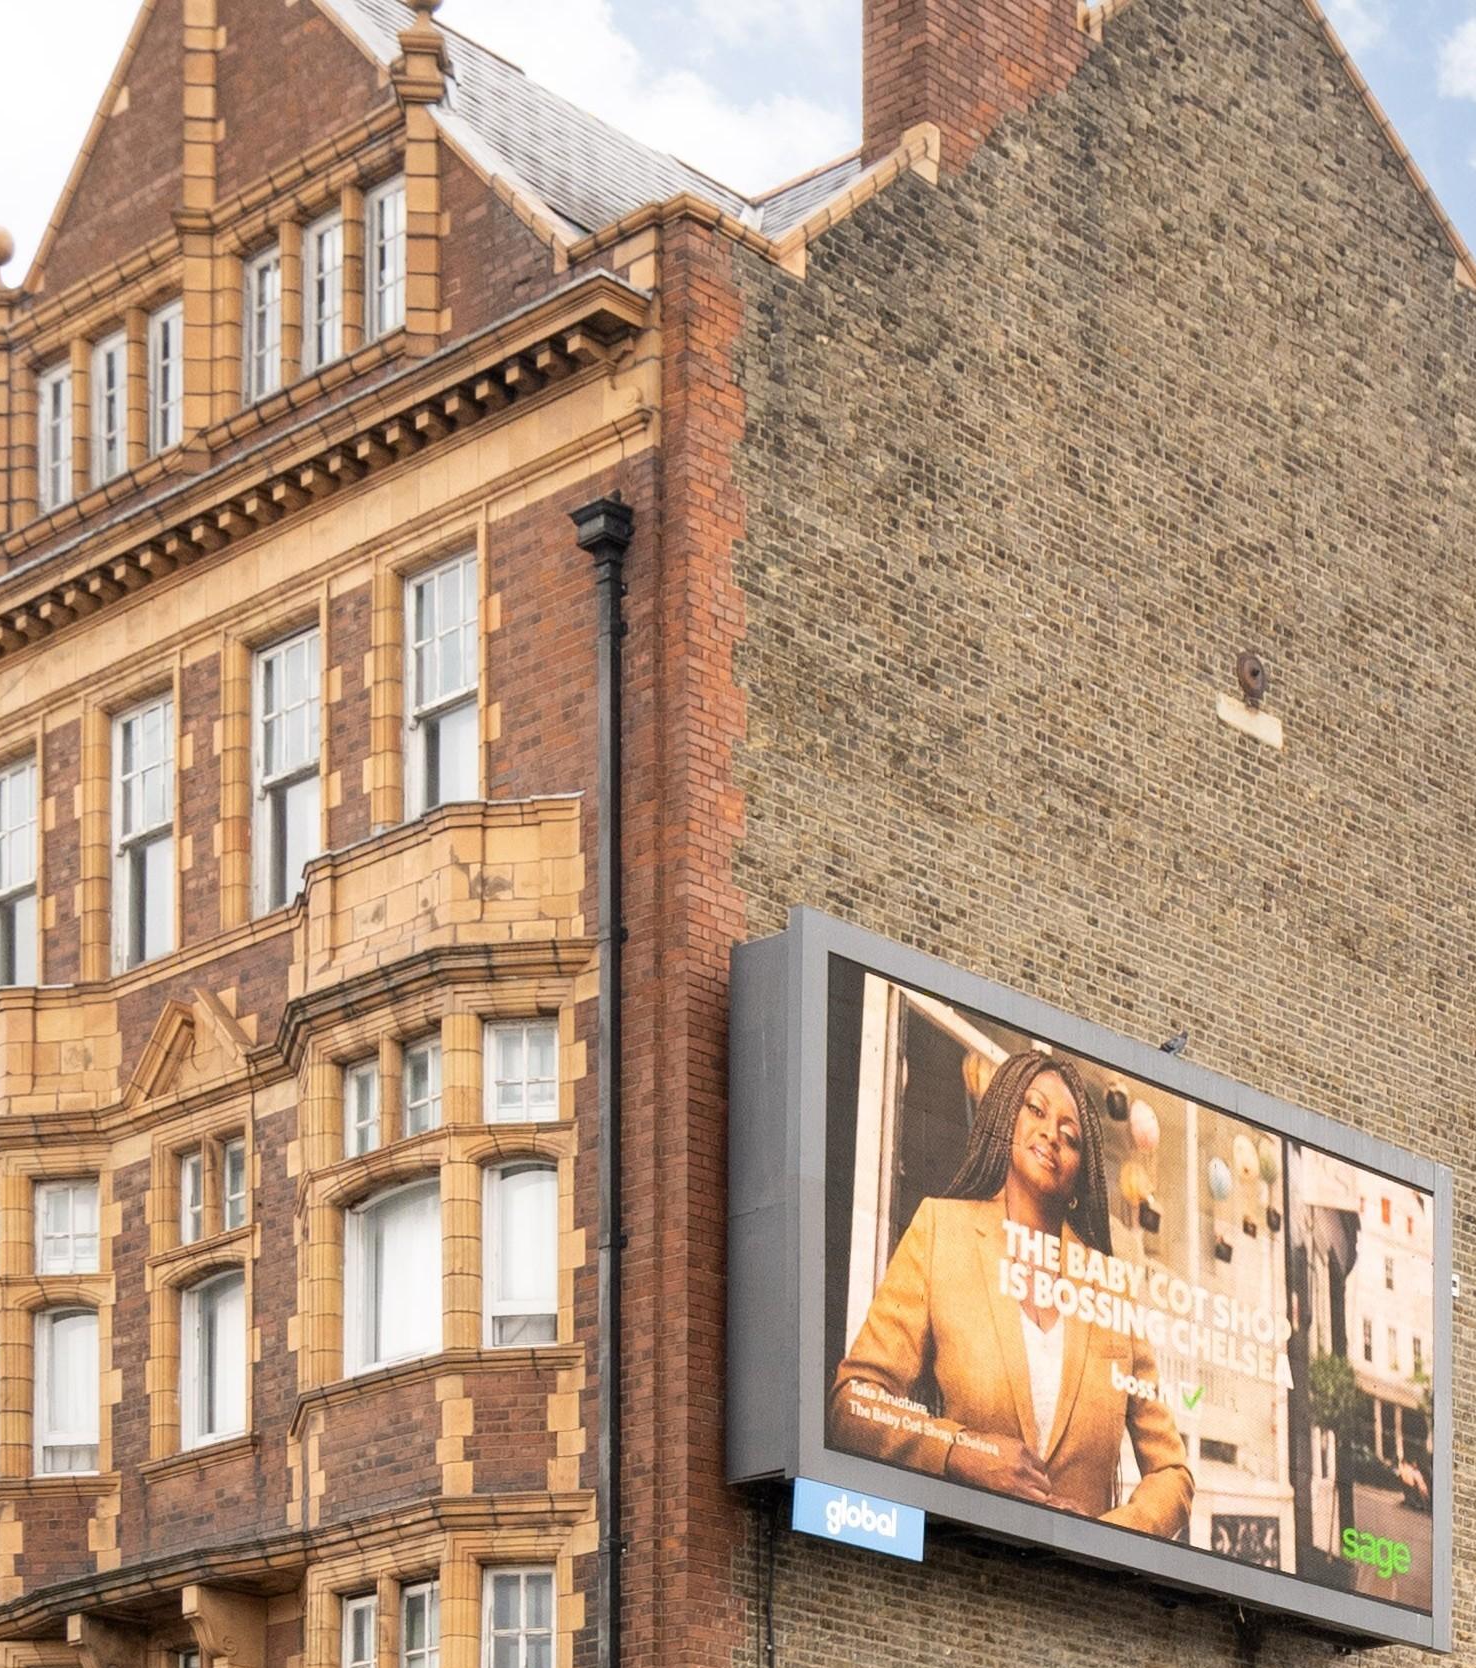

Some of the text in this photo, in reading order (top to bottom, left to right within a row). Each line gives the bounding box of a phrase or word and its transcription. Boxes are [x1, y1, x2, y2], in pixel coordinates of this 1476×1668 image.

[1002, 1219, 1292, 1343] THE BABY COT SHOP
[999, 1259, 1294, 1389] IS BOSSING CHELSEA
[1111, 1361, 1156, 1402] boss
[849, 1399, 871, 1419] The
[873, 1407, 900, 1430] Baby
[902, 1417, 922, 1434] Cot
[956, 1433, 999, 1456] Chelsea
[826, 1496, 897, 1538] global
[1343, 1527, 1412, 1578] sage
